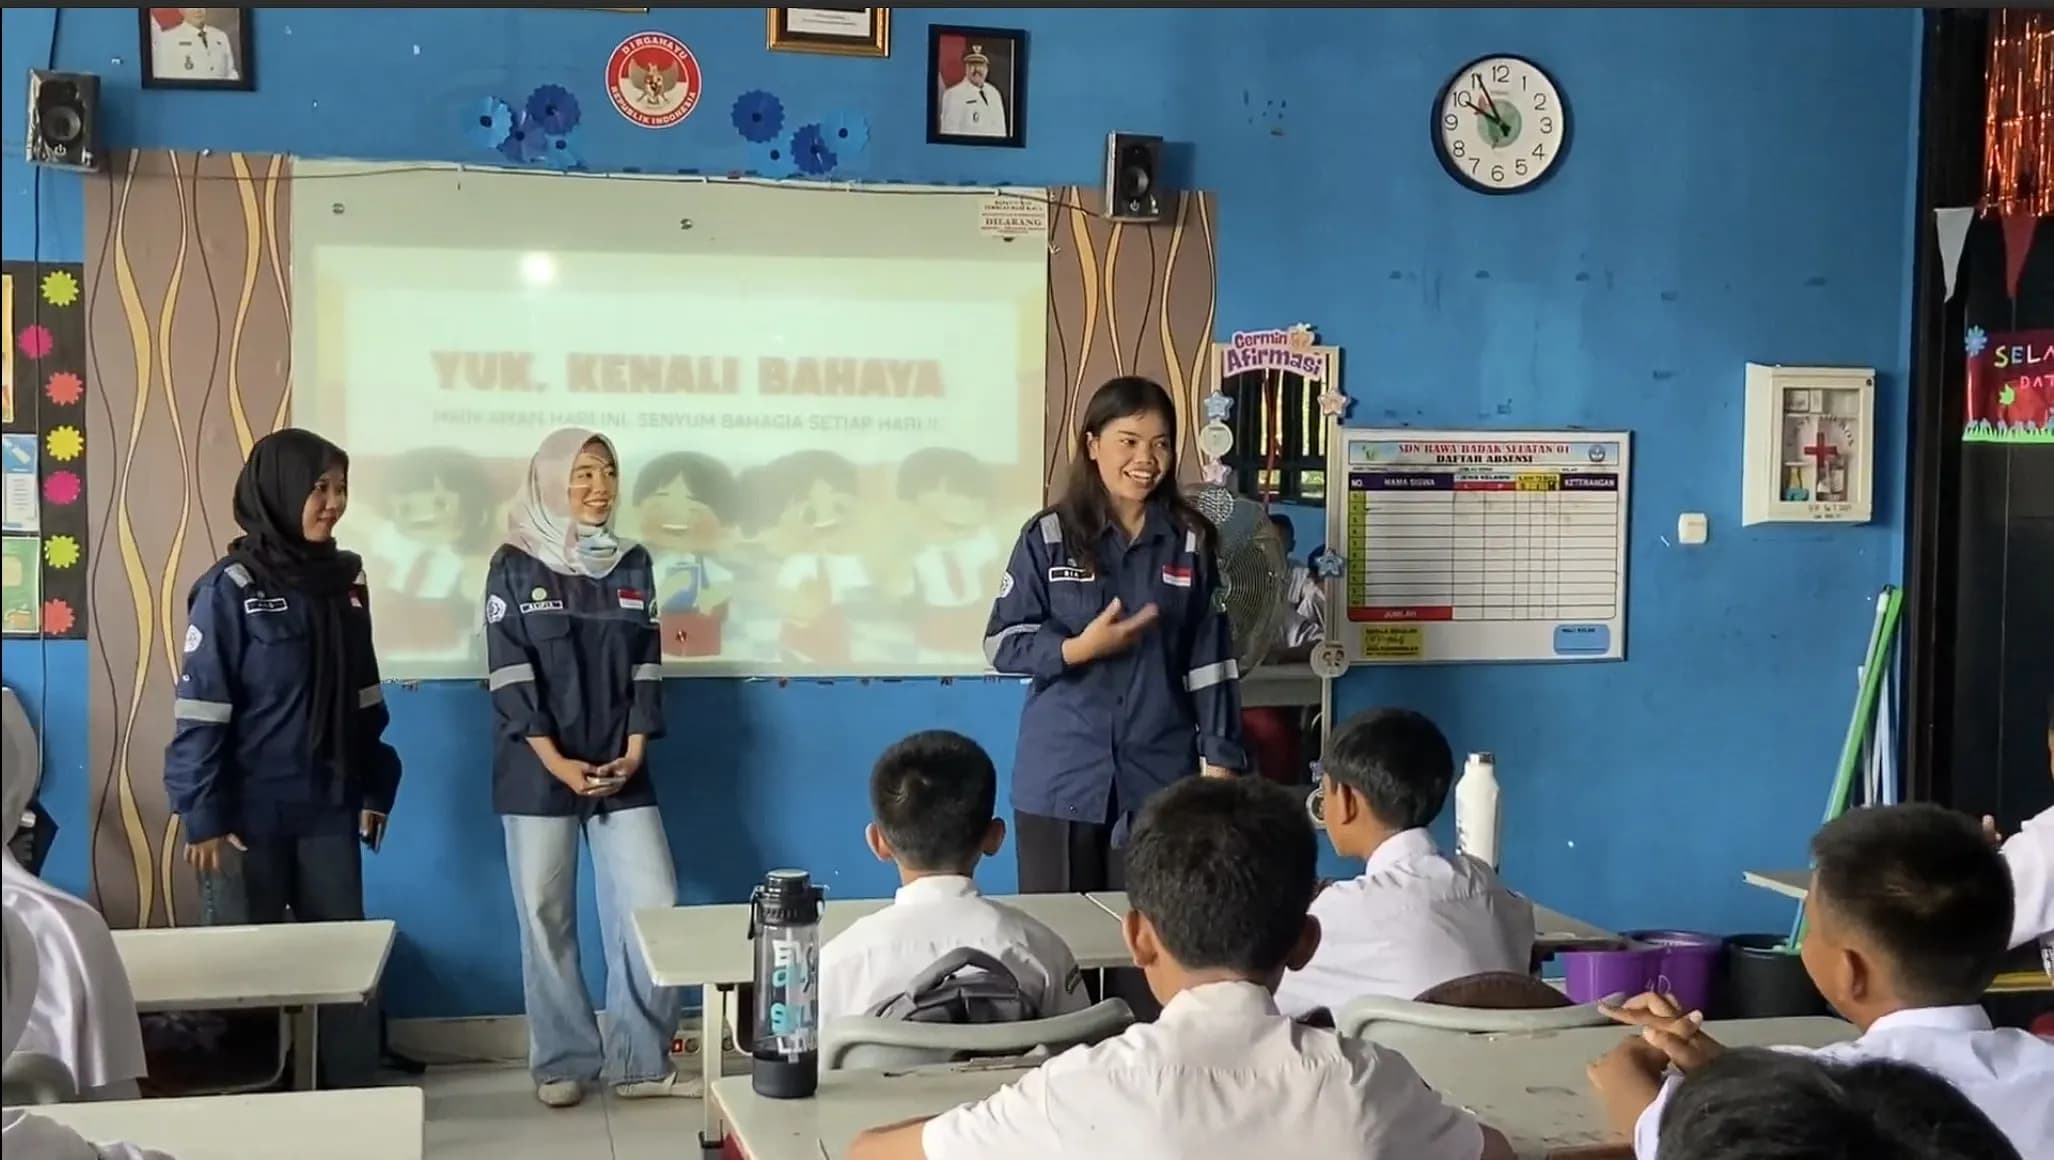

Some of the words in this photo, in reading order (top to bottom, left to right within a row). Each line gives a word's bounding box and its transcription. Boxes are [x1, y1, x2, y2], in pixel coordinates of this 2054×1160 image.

[621, 36, 688, 60] DIRGAHAYU
[1492, 65, 1510, 83] 12
[1522, 75, 1527, 91] 1
[610, 85, 650, 124] REPUBLIK
[651, 91, 697, 125] INDONESIA
[1453, 90, 1471, 107] 10
[1533, 92, 1547, 111] 2
[1444, 113, 1458, 131] 9
[1540, 117, 1553, 134] 3
[1453, 140, 1465, 158] 8
[1532, 143, 1545, 160] 4
[1469, 157, 1480, 174] 7
[1491, 165, 1504, 182] 6
[1515, 159, 1528, 176] 5
[985, 218, 1041, 226] DILARANG
[1234, 332, 1287, 348] Cermin
[1227, 348, 1322, 375] Afirmasi
[567, 353, 738, 394] KENALI
[758, 357, 945, 398] BAHAYA
[550, 411, 594, 426] HARI
[639, 412, 716, 430] SENYUM
[721, 414, 802, 430] BAHAGIA
[808, 414, 872, 431] SETIAP
[878, 416, 922, 432] HARI
[1399, 444, 1419, 453] SDN
[1425, 444, 1457, 453] RAWA
[1462, 444, 1501, 453] BADAK
[1506, 445, 1553, 453] SELATAN
[1436, 455, 1482, 463] DAFTAR
[1486, 455, 1533, 463] ABSENSI
[1384, 478, 1408, 486] NAMA
[1564, 479, 1615, 487] KETERANGAN
